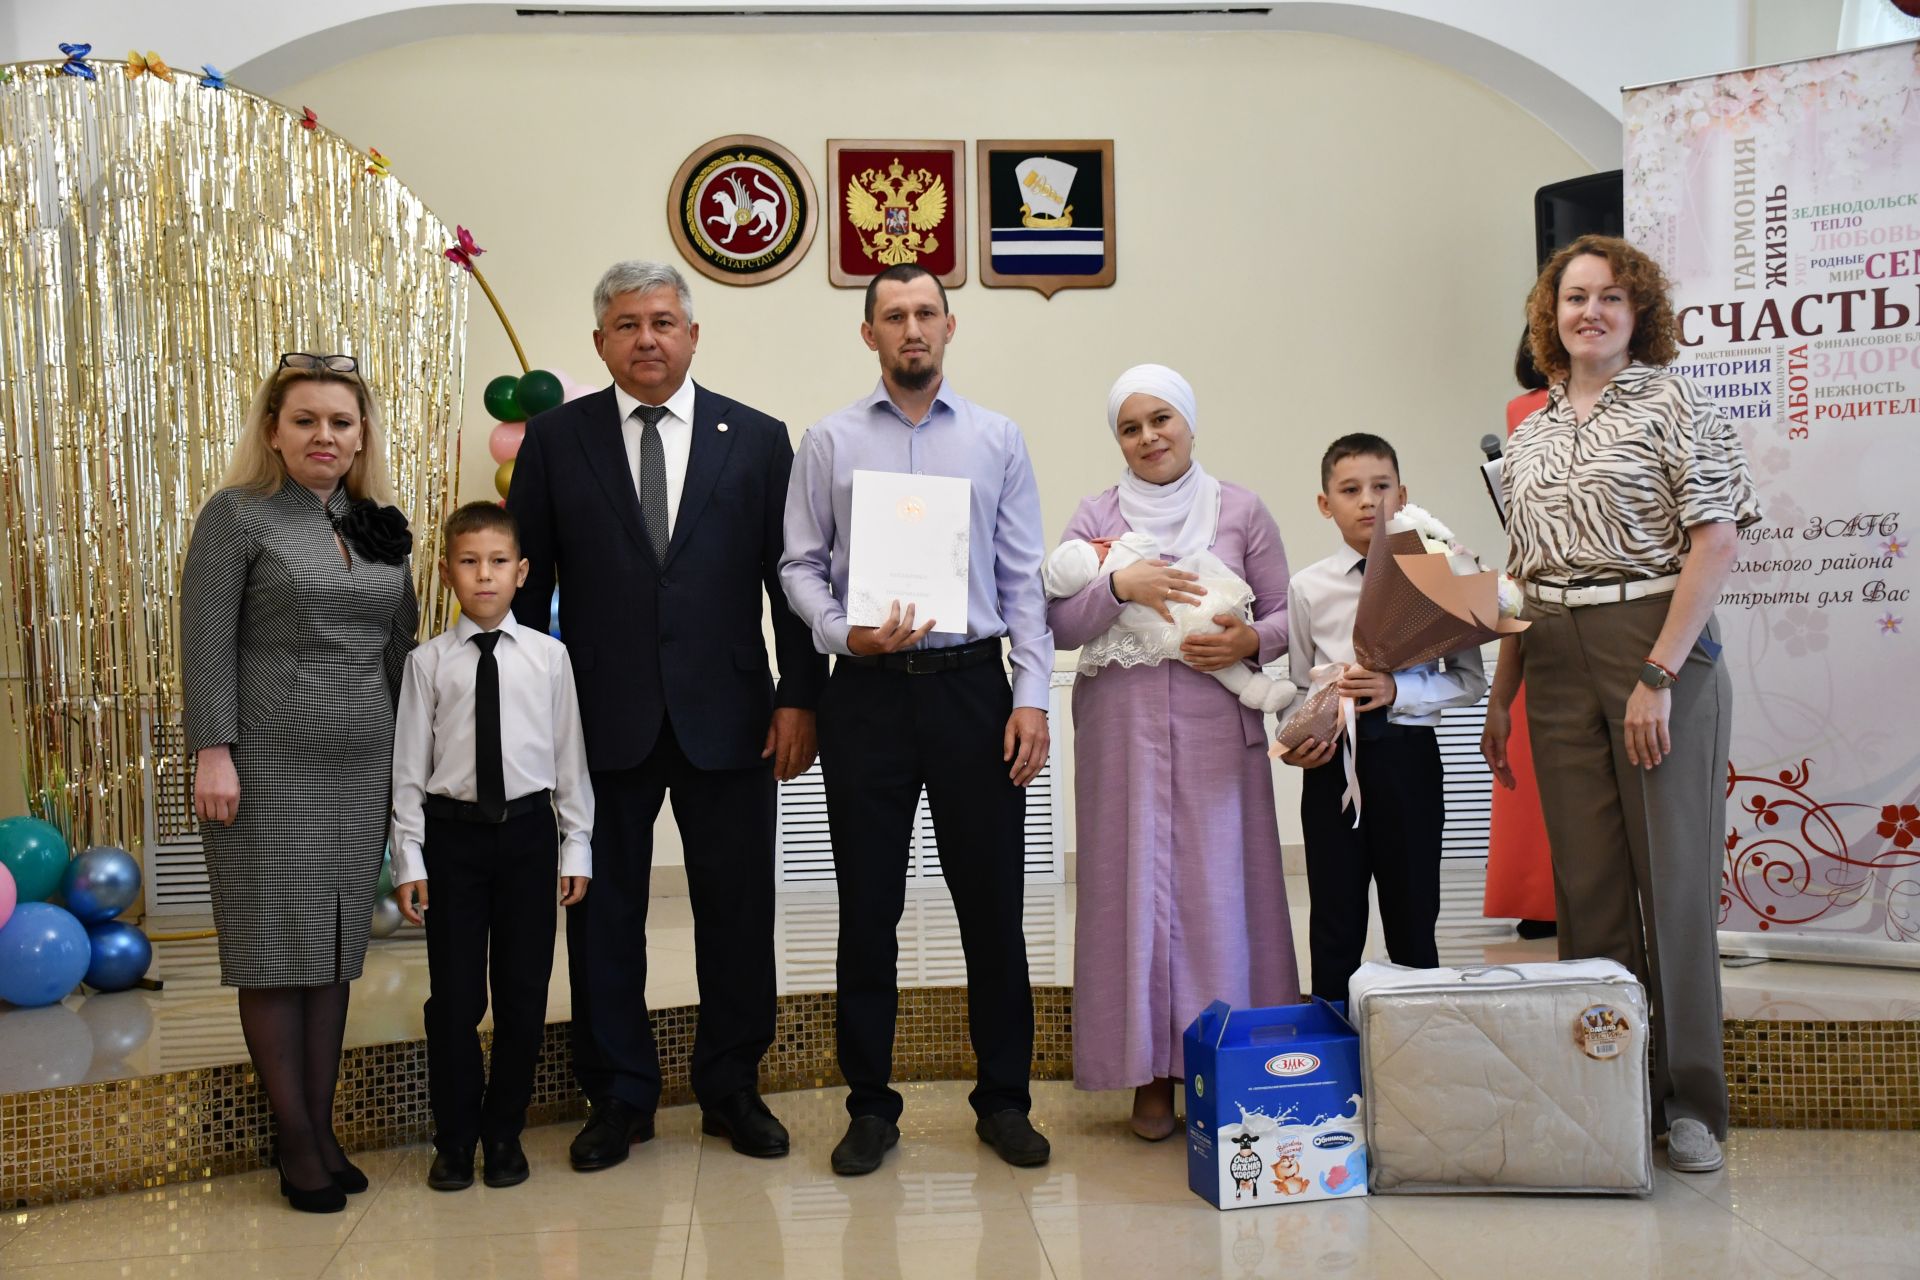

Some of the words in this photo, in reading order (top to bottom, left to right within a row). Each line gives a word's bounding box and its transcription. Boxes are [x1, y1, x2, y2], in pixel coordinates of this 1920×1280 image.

[1734, 137, 1756, 291] ГАРМОНИЯ
[1791, 192, 1919, 220] ЗЕЛЕНОДОЛЬСК
[1810, 215, 1863, 232] ТЕПЛО
[1765, 184, 1787, 290] ЖИЗНЬ
[1810, 223, 1920, 252] ЛЮБОВЬ
[714, 250, 775, 269] ТАТАРСТАН
[1794, 253, 1807, 287] УЮТ
[1810, 253, 1865, 269] РОДНЫЕ
[1829, 268, 1864, 284] МИР
[1676, 284, 1920, 347] СЧАСТЬ
[1814, 332, 1902, 350] ФИНАНСОВОЕ
[1695, 346, 1772, 361] РОДСТВЕННИКИ
[1667, 358, 1771, 379] РРИТОРИЯ
[1776, 344, 1785, 424] БЛАГОПОЛУЧИЕ
[1788, 343, 1809, 441] ЗАБОТА
[1815, 380, 1906, 399] НЕЖНОСТЬ
[1815, 398, 1920, 421] РОДИТЕЛ
[1736, 526, 1794, 545] тдела
[1803, 512, 1900, 540] ЗАГС
[1815, 553, 1894, 576] района
[1818, 589, 1853, 609] для
[1862, 578, 1910, 603] Вас
[1276, 1058, 1307, 1070] ЗМК
[1231, 1161, 1261, 1171] ВАЖНАЯ
[1233, 1154, 1259, 1164] ОЧЕНЬ
[1233, 1169, 1261, 1179] КОРОВА
